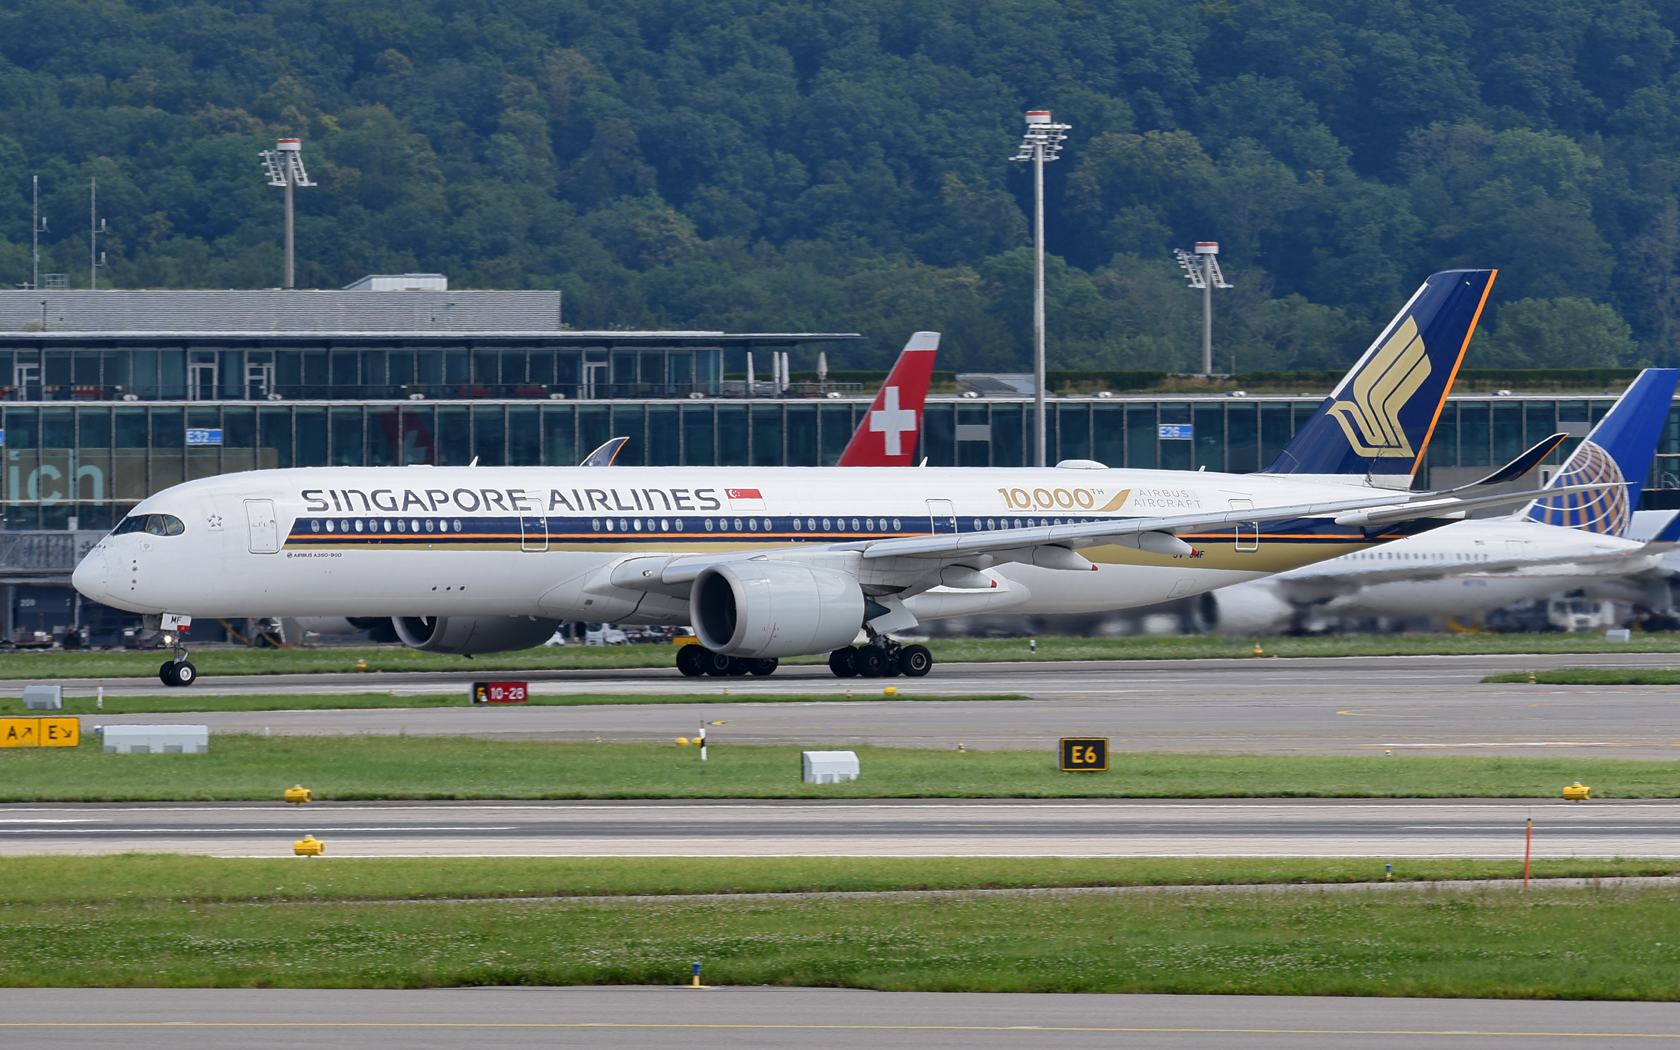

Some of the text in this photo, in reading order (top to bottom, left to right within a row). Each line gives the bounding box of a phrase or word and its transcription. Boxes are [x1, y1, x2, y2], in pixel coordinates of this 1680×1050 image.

[186, 431, 209, 443] E32
[1159, 426, 1180, 438] E26
[0, 449, 104, 506] ich
[1139, 489, 1189, 498] AIRBUS
[301, 488, 721, 512] SINGAPORE AIRLINES
[1134, 499, 1201, 508] AIRCRAFT
[170, 615, 182, 625] MF
[490, 687, 525, 700] 10-28
[6, 725, 58, 740] A E
[1071, 745, 1098, 764] E6
